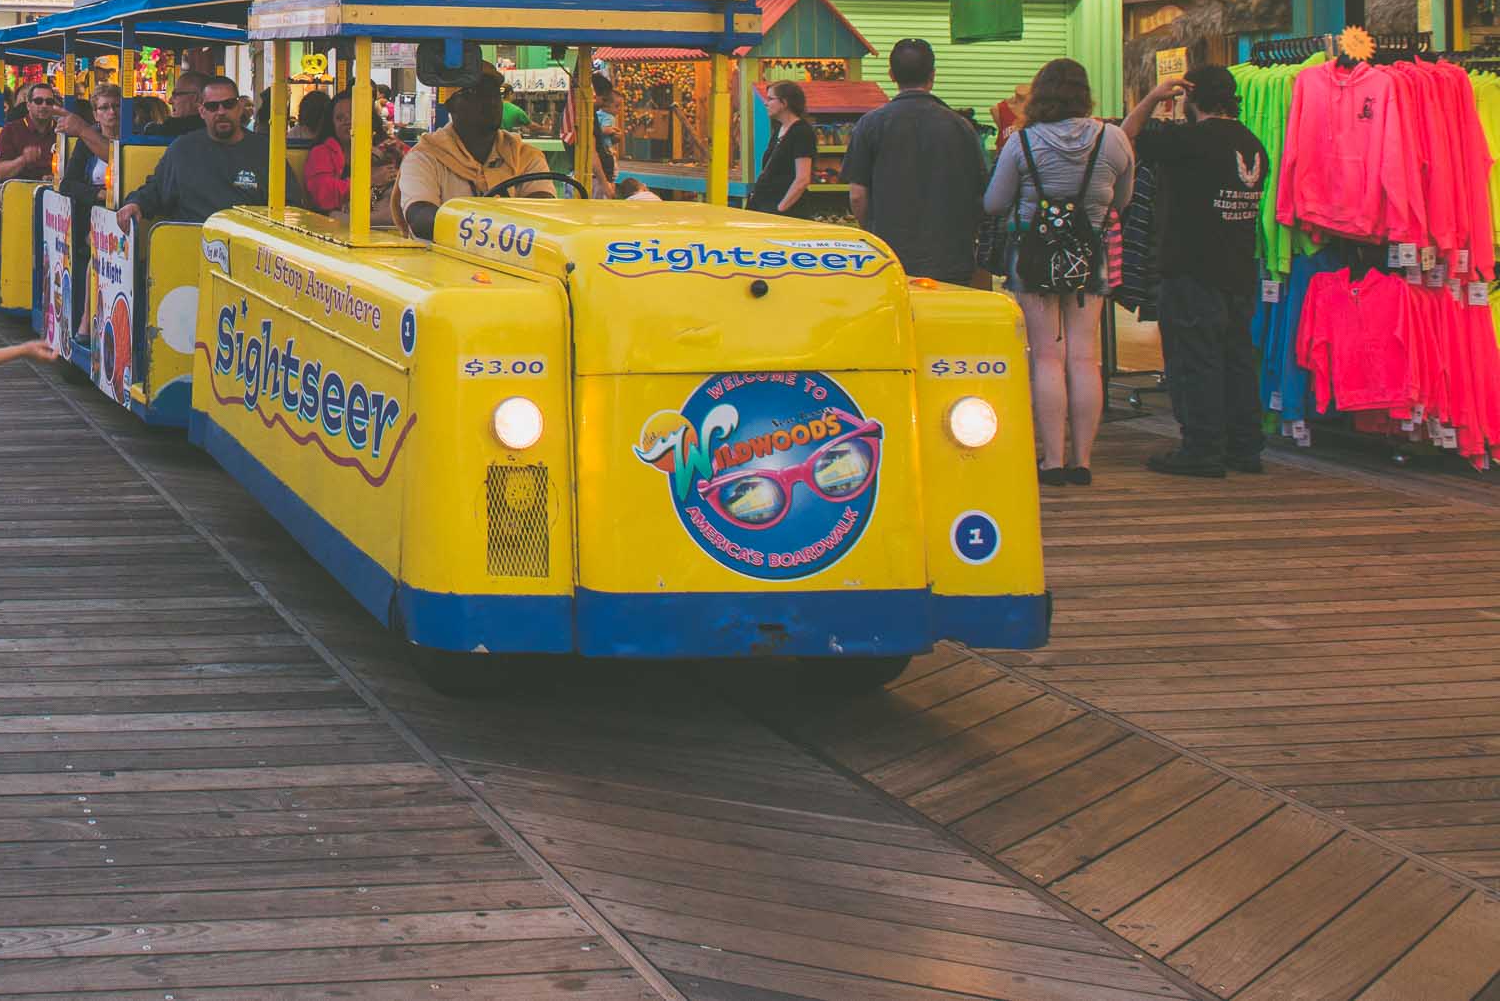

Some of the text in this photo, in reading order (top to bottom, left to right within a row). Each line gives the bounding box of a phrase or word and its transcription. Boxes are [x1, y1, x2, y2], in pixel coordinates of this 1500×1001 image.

[458, 212, 536, 258] $3.00
[606, 239, 878, 273] Sightseer
[106, 260, 122, 285] Night
[254, 245, 382, 331] I'll Stop Anywhere
[214, 301, 400, 458] Sightseer
[463, 357, 545, 377] $3.00
[931, 358, 1007, 377] $3.00
[707, 372, 828, 400] WELCOME TO
[686, 505, 859, 568] AMERICA'S BOARDWALK
[968, 527, 984, 545] 1
